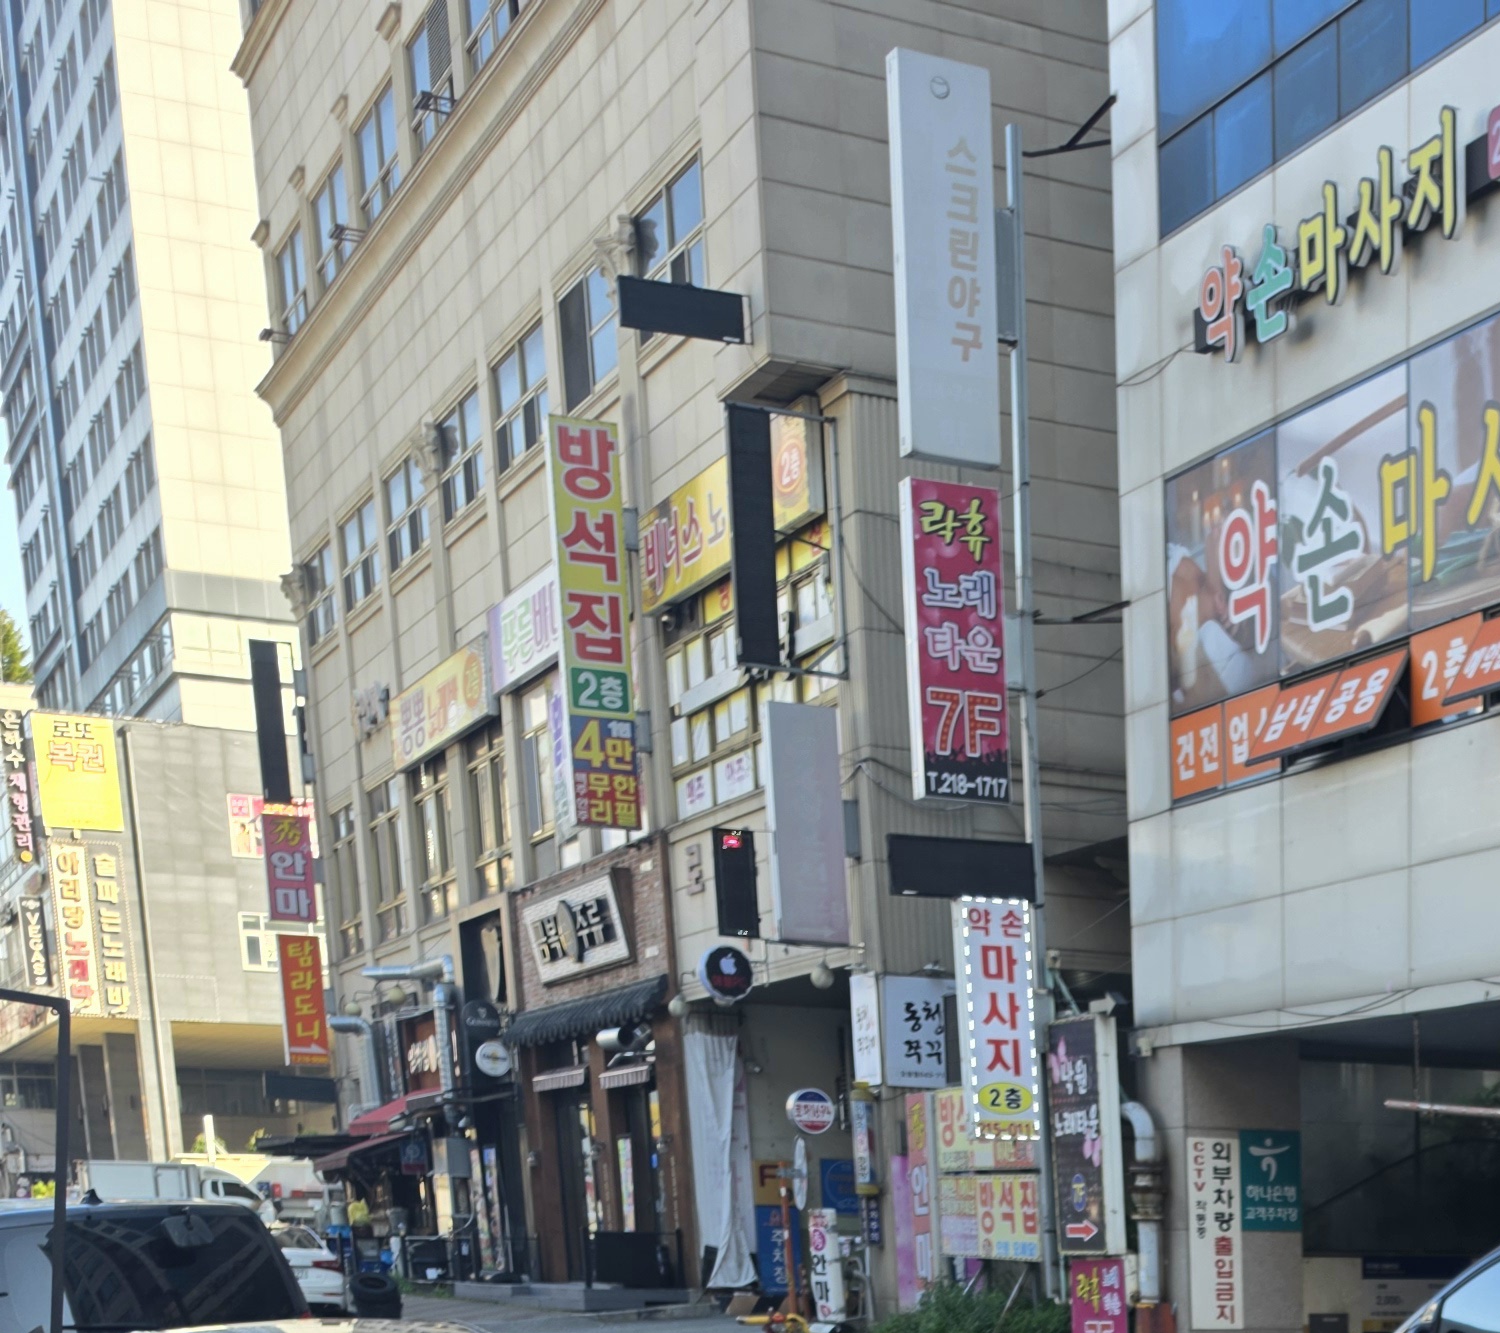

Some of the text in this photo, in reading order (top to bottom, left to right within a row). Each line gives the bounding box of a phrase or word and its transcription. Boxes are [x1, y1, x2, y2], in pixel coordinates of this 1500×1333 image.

[944, 135, 983, 363] 스크린야구
[781, 449, 801, 487] 2층
[555, 425, 625, 666] 방석집
[642, 496, 704, 597] 비너스
[919, 497, 990, 564] 락휴
[922, 567, 997, 619] 노래
[924, 621, 1002, 674] 타운
[577, 670, 625, 712] 2층
[1, 709, 25, 769] 은하수
[52, 720, 95, 740] 로또
[926, 686, 1002, 758] 7F
[47, 740, 106, 774] 복권
[269, 850, 312, 919] 안마
[26, 911, 46, 978] VEGAS
[967, 907, 1024, 938] 약손
[287, 940, 321, 1041] 탐라도니
[980, 944, 1022, 1078] 마사지
[988, 1087, 1022, 1110] 2층
[1193, 1141, 1206, 1194] CCTV
[1245, 1185, 1298, 1204] 하나은행
[979, 1180, 1038, 1235] 방석집
[1211, 1141, 1236, 1325] 외부차량 출입금지
[1244, 1206, 1299, 1223] 고객주차장
